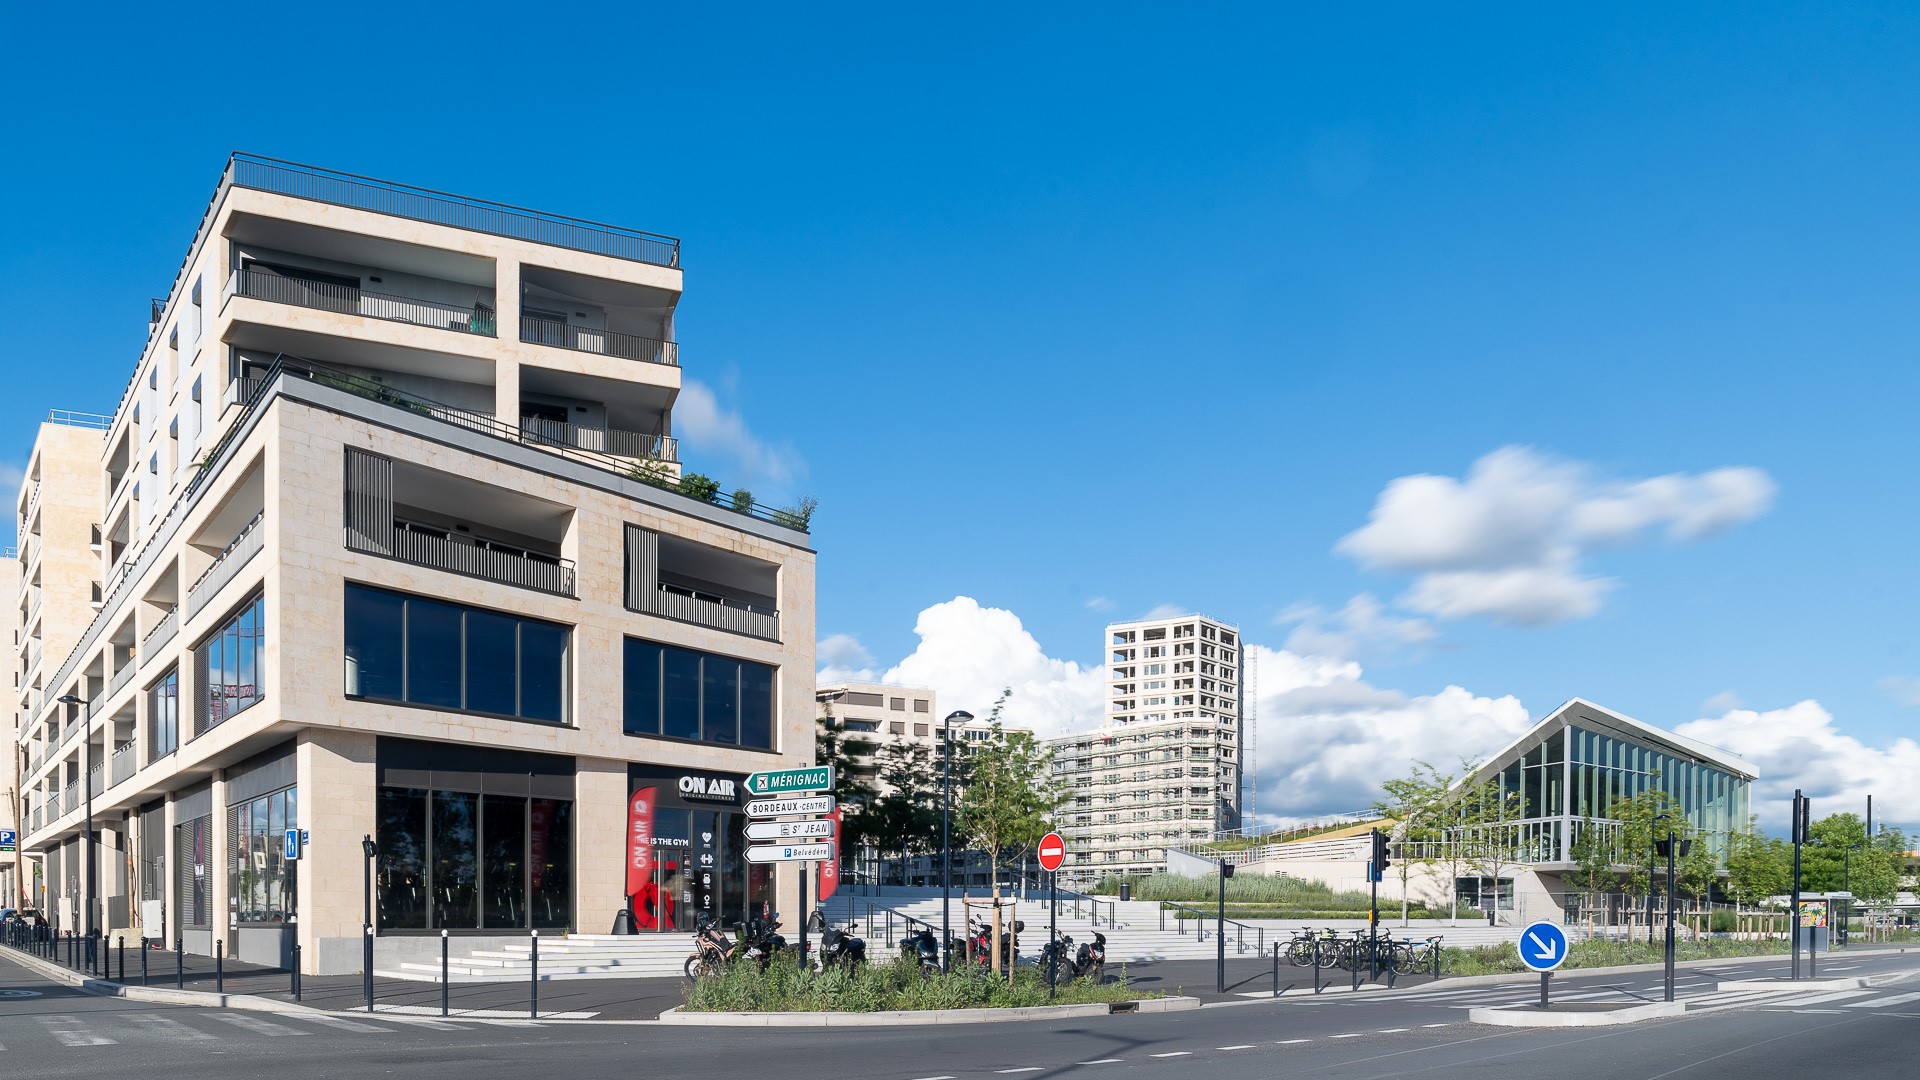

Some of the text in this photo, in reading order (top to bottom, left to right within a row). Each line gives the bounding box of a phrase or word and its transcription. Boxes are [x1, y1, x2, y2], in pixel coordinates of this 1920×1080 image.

[679, 776, 735, 796] ON AIR
[771, 773, 826, 787] MÉRIGNAC
[805, 824, 827, 833] JEAN
[650, 837, 658, 845] IS
[658, 838, 672, 846] THE
[673, 838, 689, 847] GYM
[634, 846, 647, 869] ON
[793, 848, 827, 856] Belvédère
